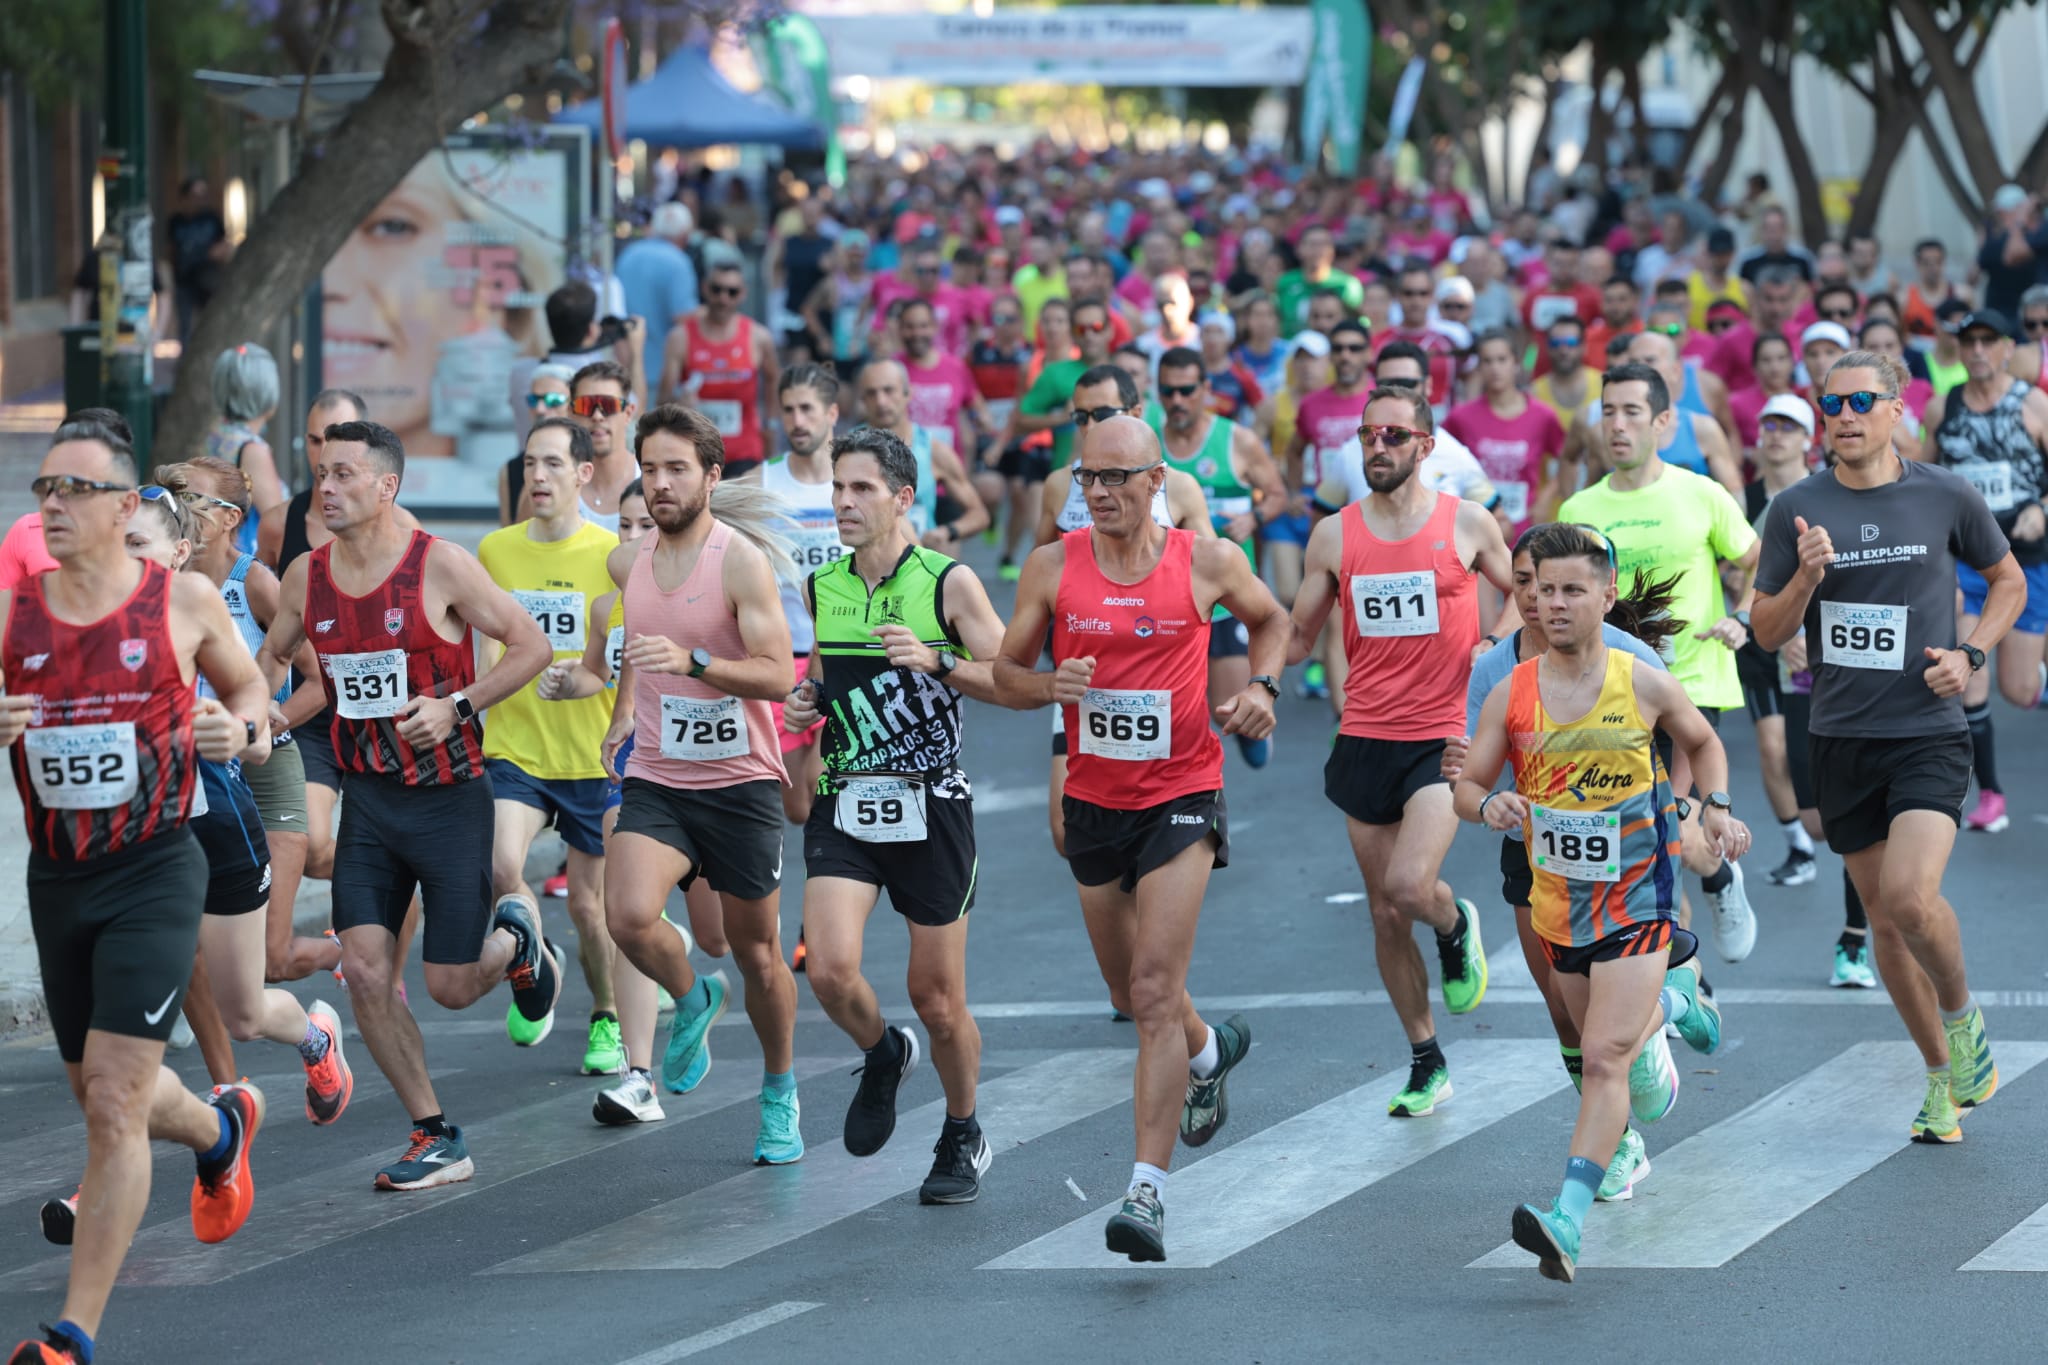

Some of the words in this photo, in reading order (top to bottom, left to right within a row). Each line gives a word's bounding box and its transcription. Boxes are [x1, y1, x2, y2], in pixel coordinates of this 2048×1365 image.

[1833, 551, 1860, 563] BAN
[1862, 545, 1928, 560] EXPLORER
[1364, 593, 1425, 620] 611
[528, 612, 576, 635] 19
[1073, 618, 1111, 631] califas
[1831, 624, 1896, 652] 696
[343, 672, 398, 702] 531
[672, 718, 737, 744] 726
[1089, 712, 1159, 742] 669
[41, 753, 125, 787] 552
[1575, 762, 1634, 790] Álora
[857, 799, 903, 825] 59
[1170, 814, 1206, 825] Joma
[1541, 830, 1609, 862] 189
